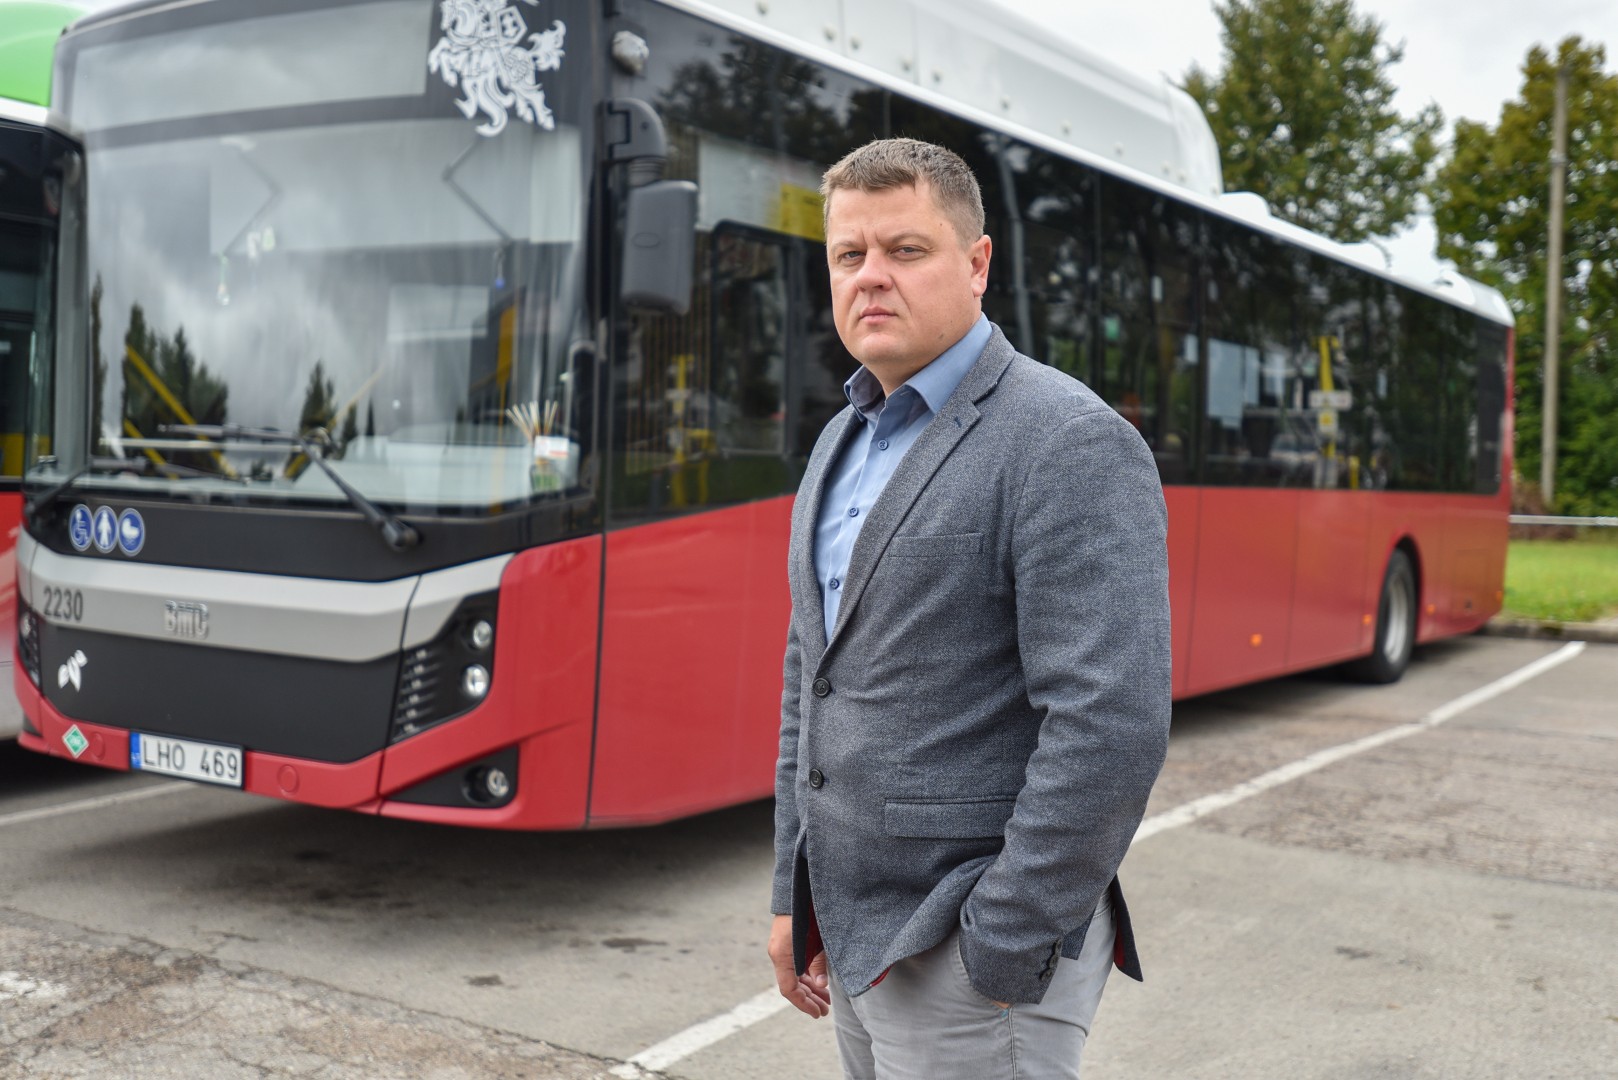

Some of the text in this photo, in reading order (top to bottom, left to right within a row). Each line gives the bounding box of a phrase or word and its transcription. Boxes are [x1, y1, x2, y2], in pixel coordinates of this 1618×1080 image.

[43, 585, 83, 622] 2230
[143, 740, 238, 778] LHO 469
